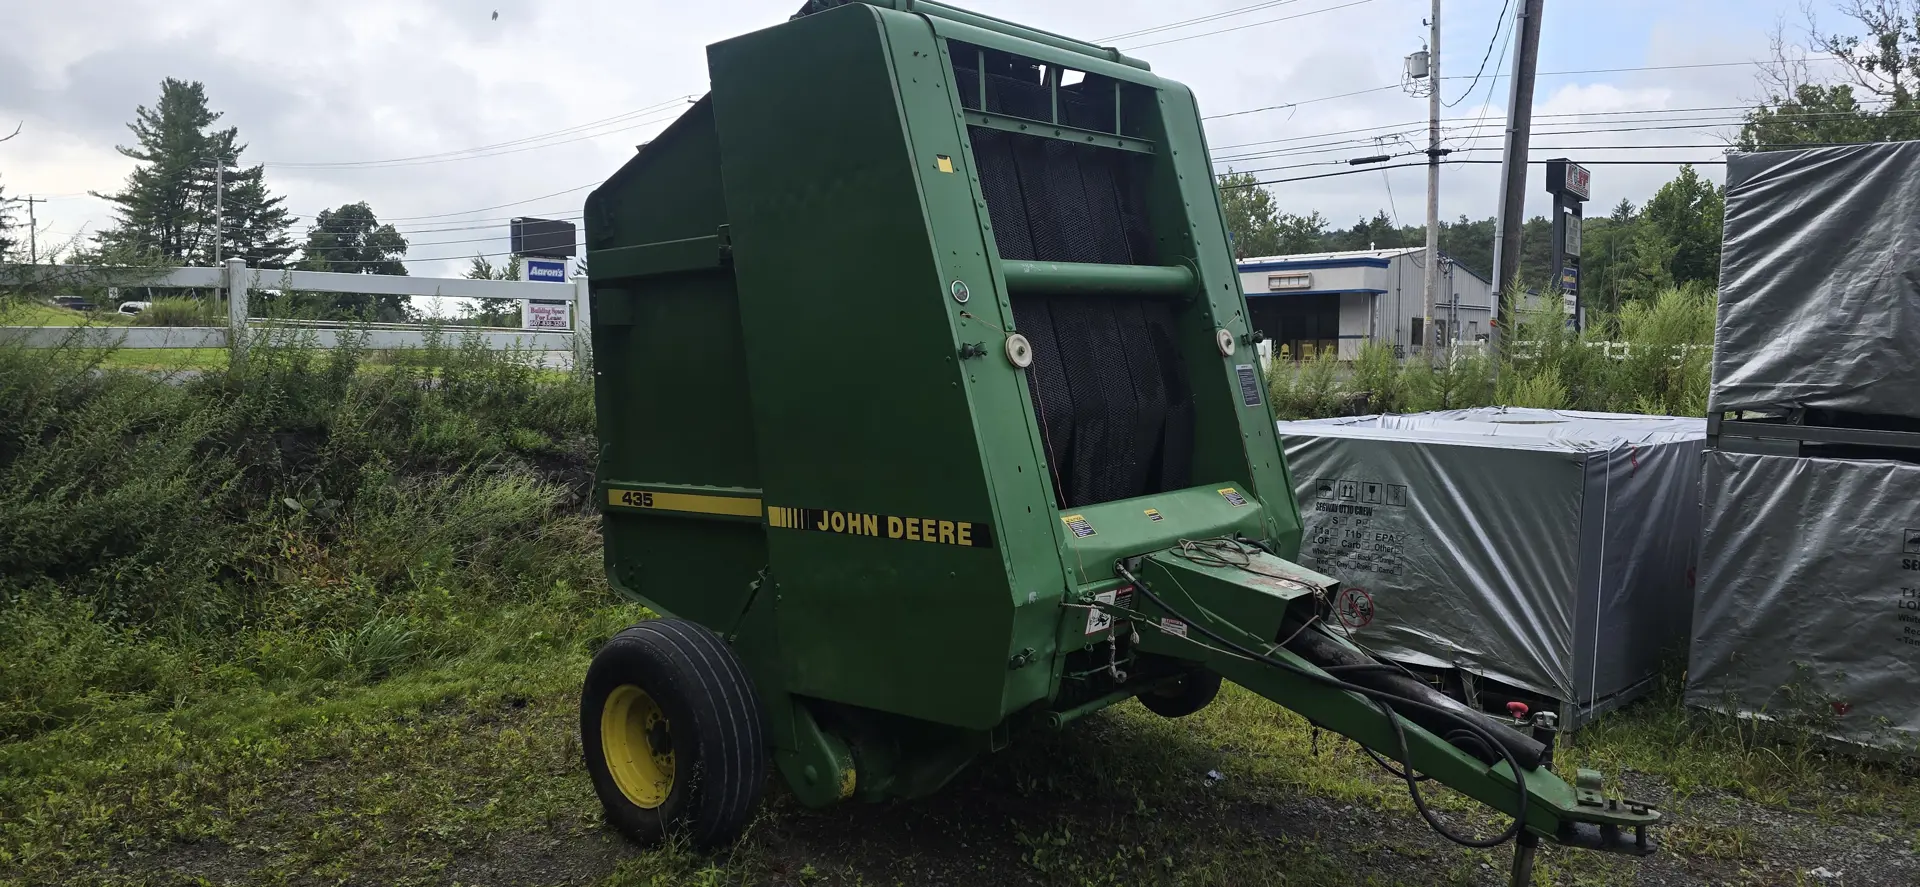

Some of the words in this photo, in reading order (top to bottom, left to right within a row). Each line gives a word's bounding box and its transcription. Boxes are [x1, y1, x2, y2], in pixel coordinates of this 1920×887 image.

[530, 266, 564, 277] Aaron's
[530, 307, 551, 315] Building
[622, 492, 653, 507] 435
[1354, 506, 1373, 516] CREW
[1332, 516, 1338, 525] S
[817, 510, 878, 537] JOHN
[887, 516, 973, 546] DEERE
[1314, 526, 1329, 535] T1a
[1345, 530, 1362, 539] T1b
[1376, 534, 1395, 543] EPA
[1342, 540, 1361, 549] Carb
[1375, 544, 1394, 553] Other
[1902, 558, 1920, 571] SE
